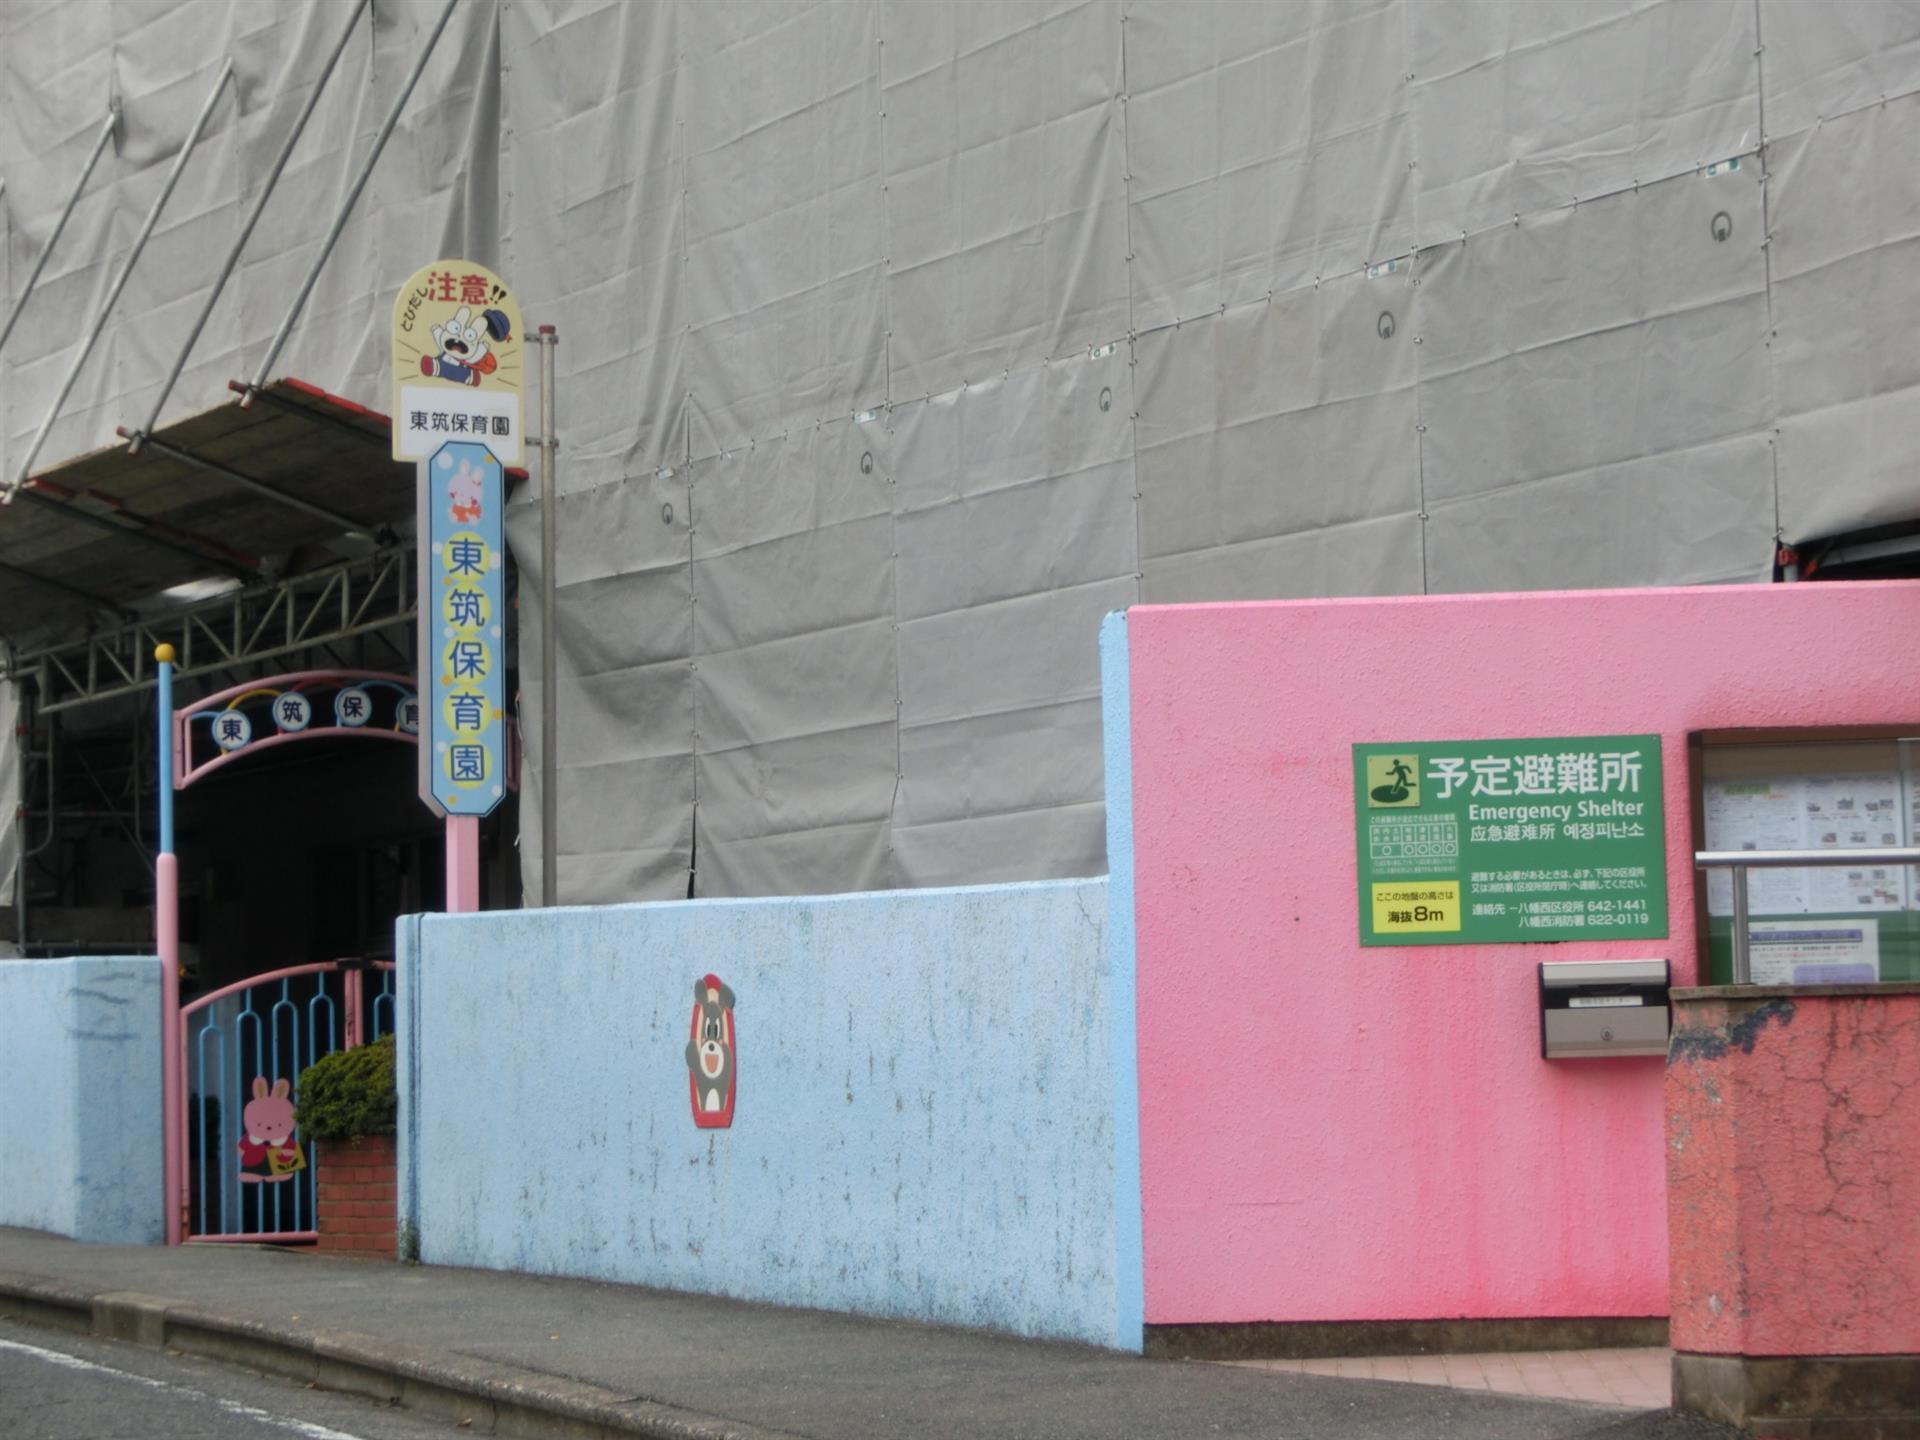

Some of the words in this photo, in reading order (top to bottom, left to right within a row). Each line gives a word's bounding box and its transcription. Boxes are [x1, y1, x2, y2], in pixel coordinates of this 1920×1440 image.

[410, 411, 510, 436] 東筑保育園
[448, 537, 486, 781] 東筑保育園
[1427, 751, 1642, 799] 予定避難所
[1469, 803, 1571, 822] Emergency
[1578, 799, 1644, 817] Shelter
[1587, 900, 1647, 912] 642-1441
[1587, 913, 1649, 926] 622-0119
